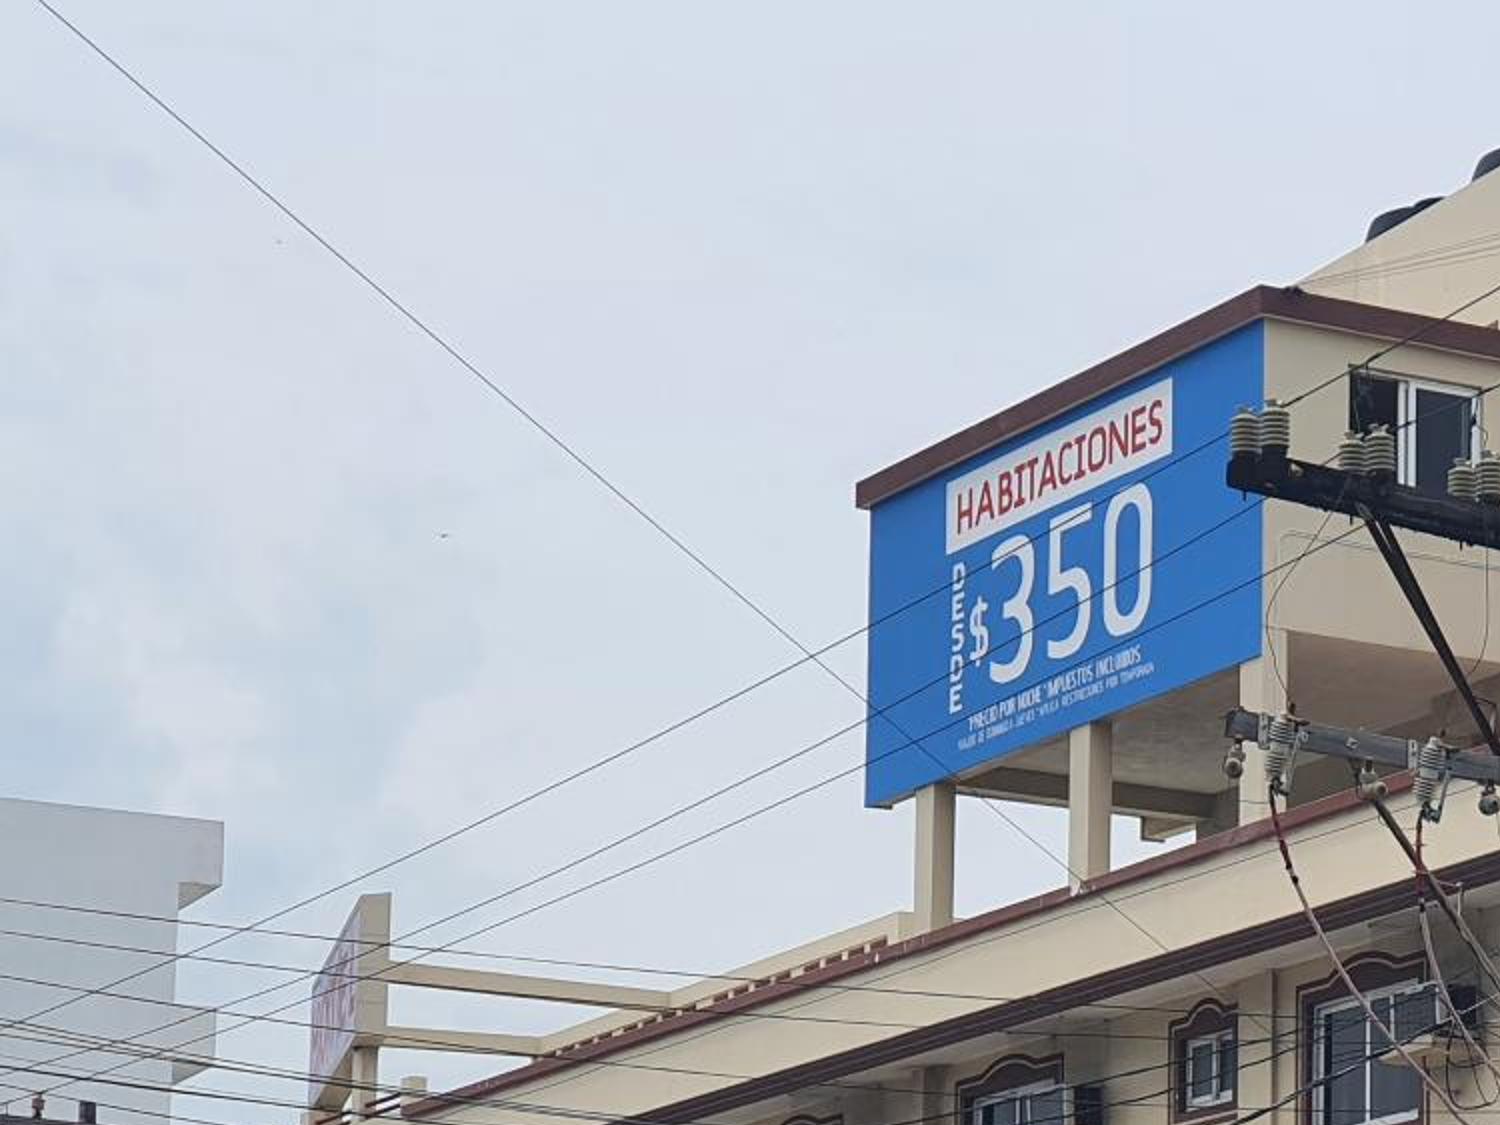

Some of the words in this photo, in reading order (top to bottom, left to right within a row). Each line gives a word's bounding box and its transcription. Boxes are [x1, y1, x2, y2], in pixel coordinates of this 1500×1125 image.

[957, 400, 1163, 535] HABITACIONES
[949, 562, 966, 715] DESDE
[969, 482, 1153, 684] $350
